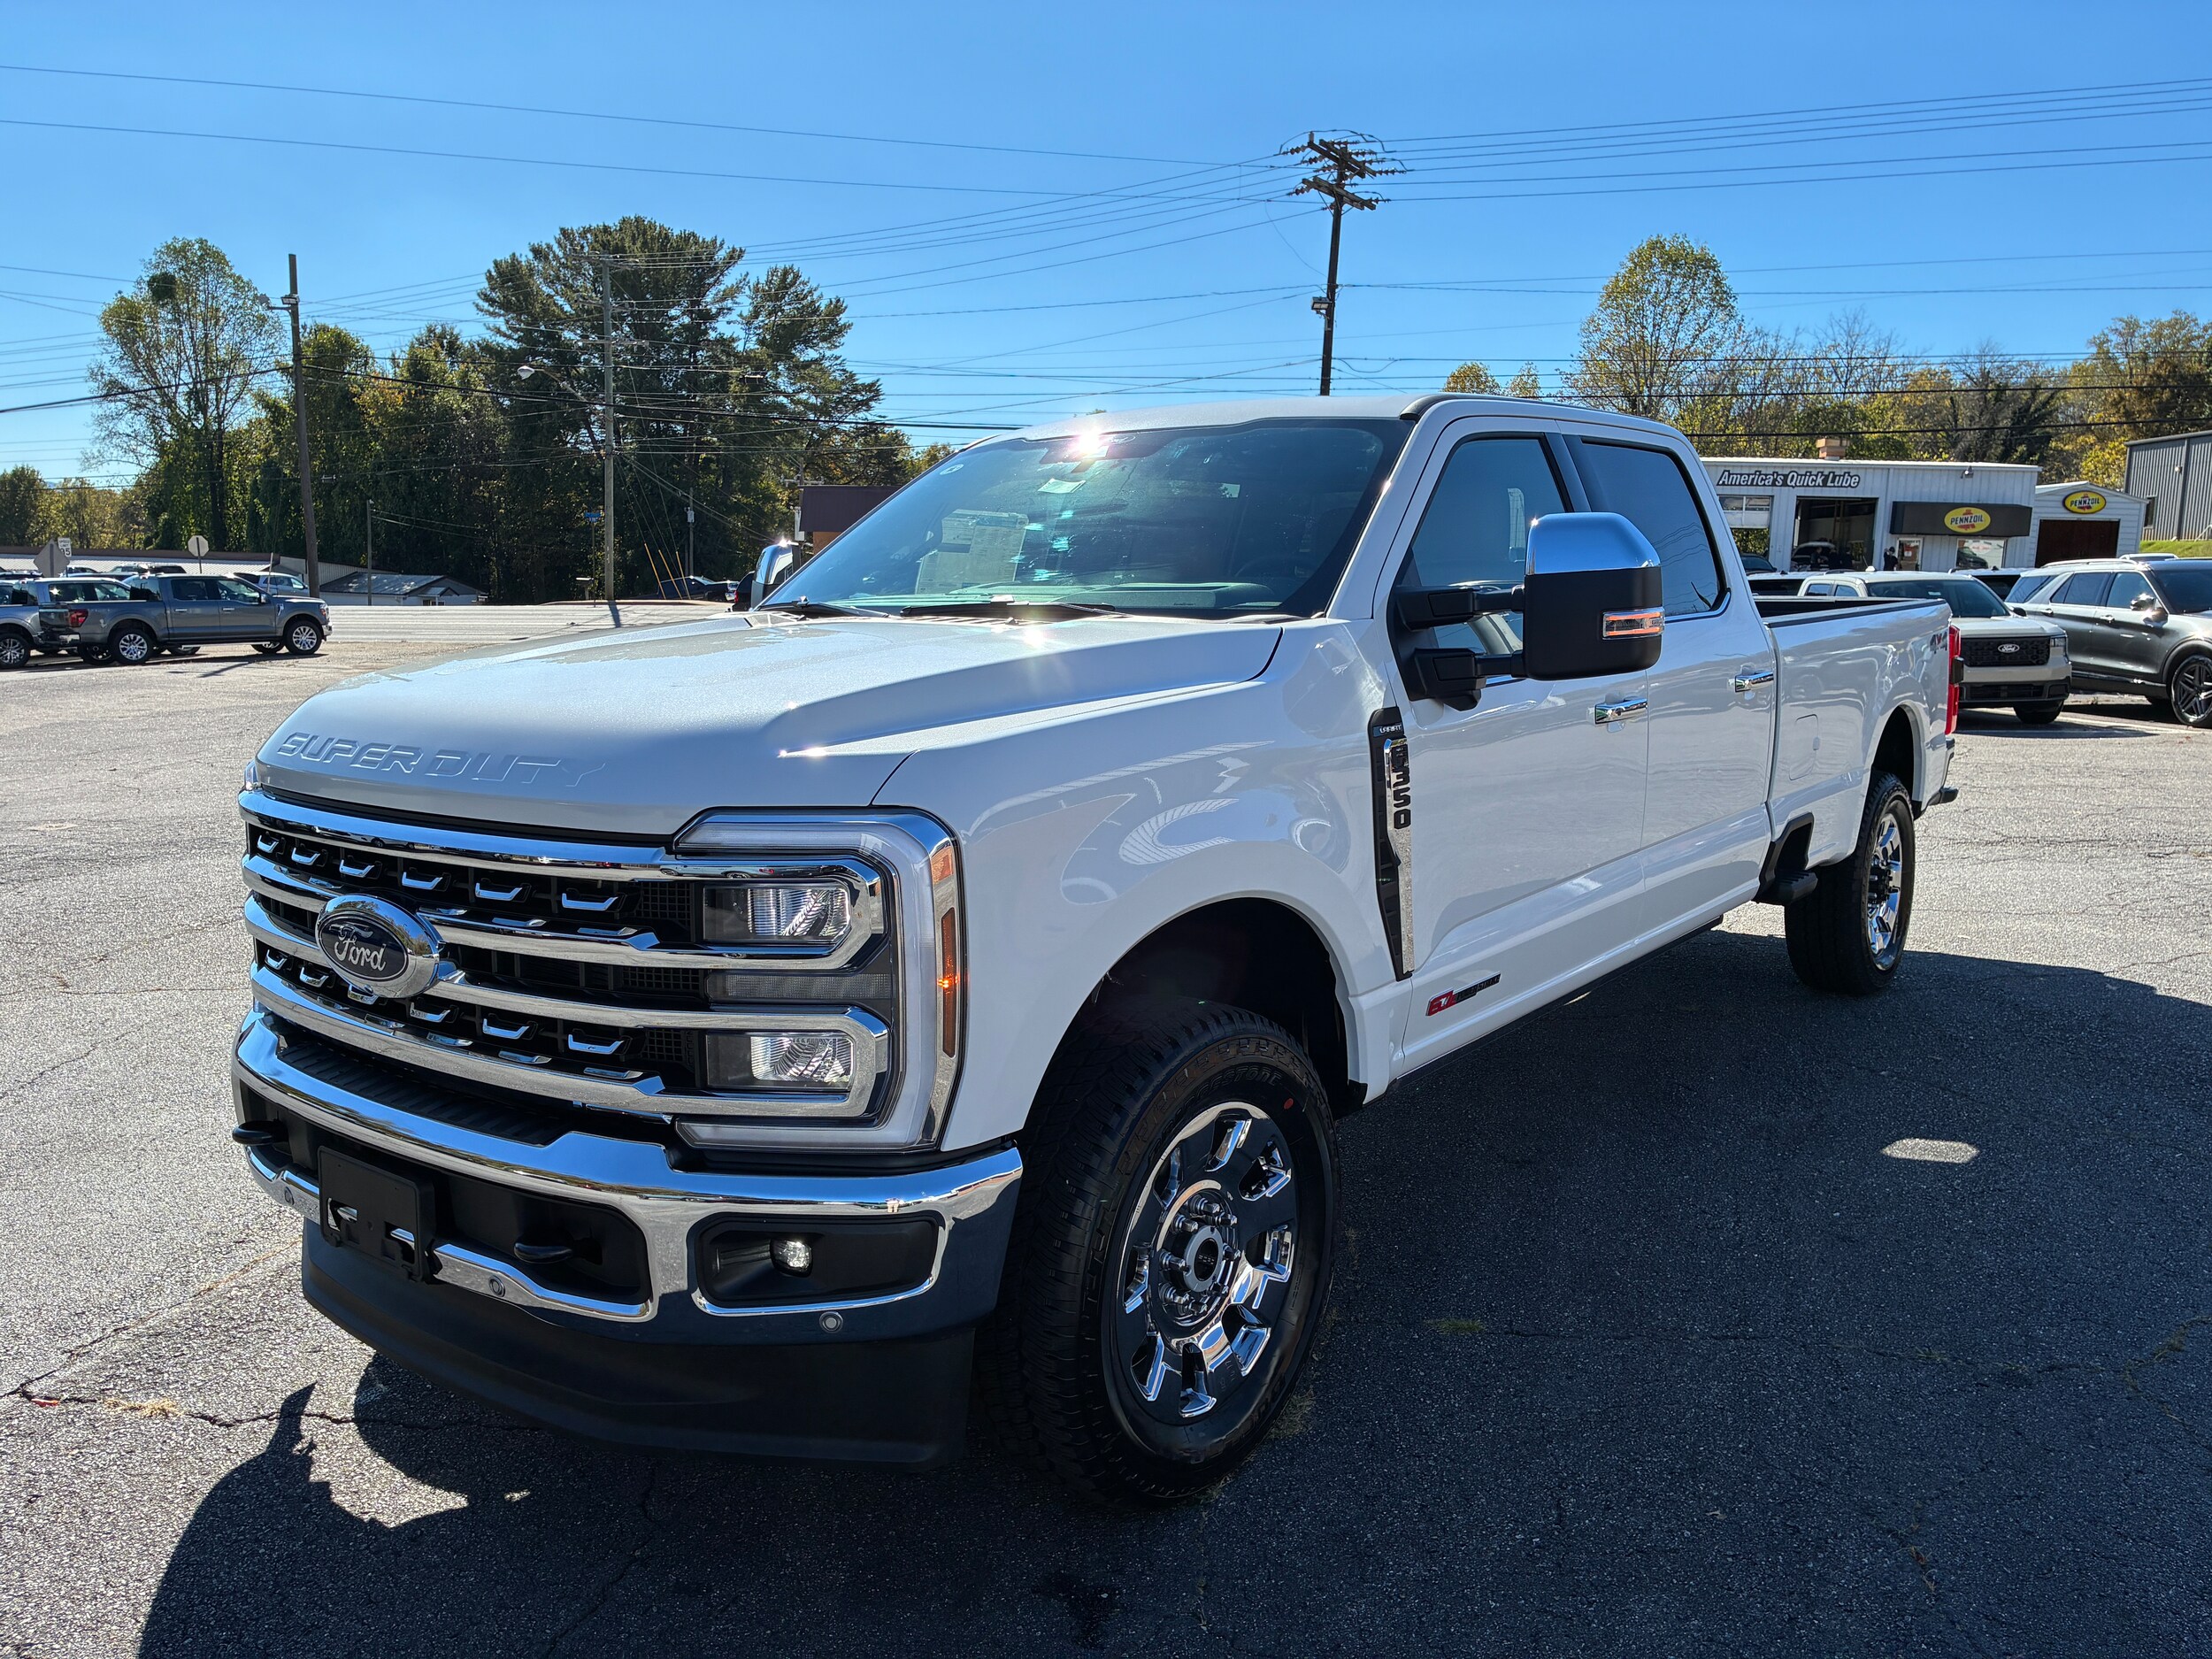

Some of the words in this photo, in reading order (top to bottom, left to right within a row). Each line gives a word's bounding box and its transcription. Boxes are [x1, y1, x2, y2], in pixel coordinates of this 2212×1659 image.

[1718, 471, 1784, 486] America's
[1786, 472, 1824, 488] Quick
[1826, 472, 1859, 487] Lube
[2070, 497, 2101, 507] PENNZOIL
[1949, 513, 1984, 525] PENNZOIL
[278, 731, 424, 773] SUPER
[425, 749, 606, 787] DUTY
[328, 922, 387, 972] Ford
